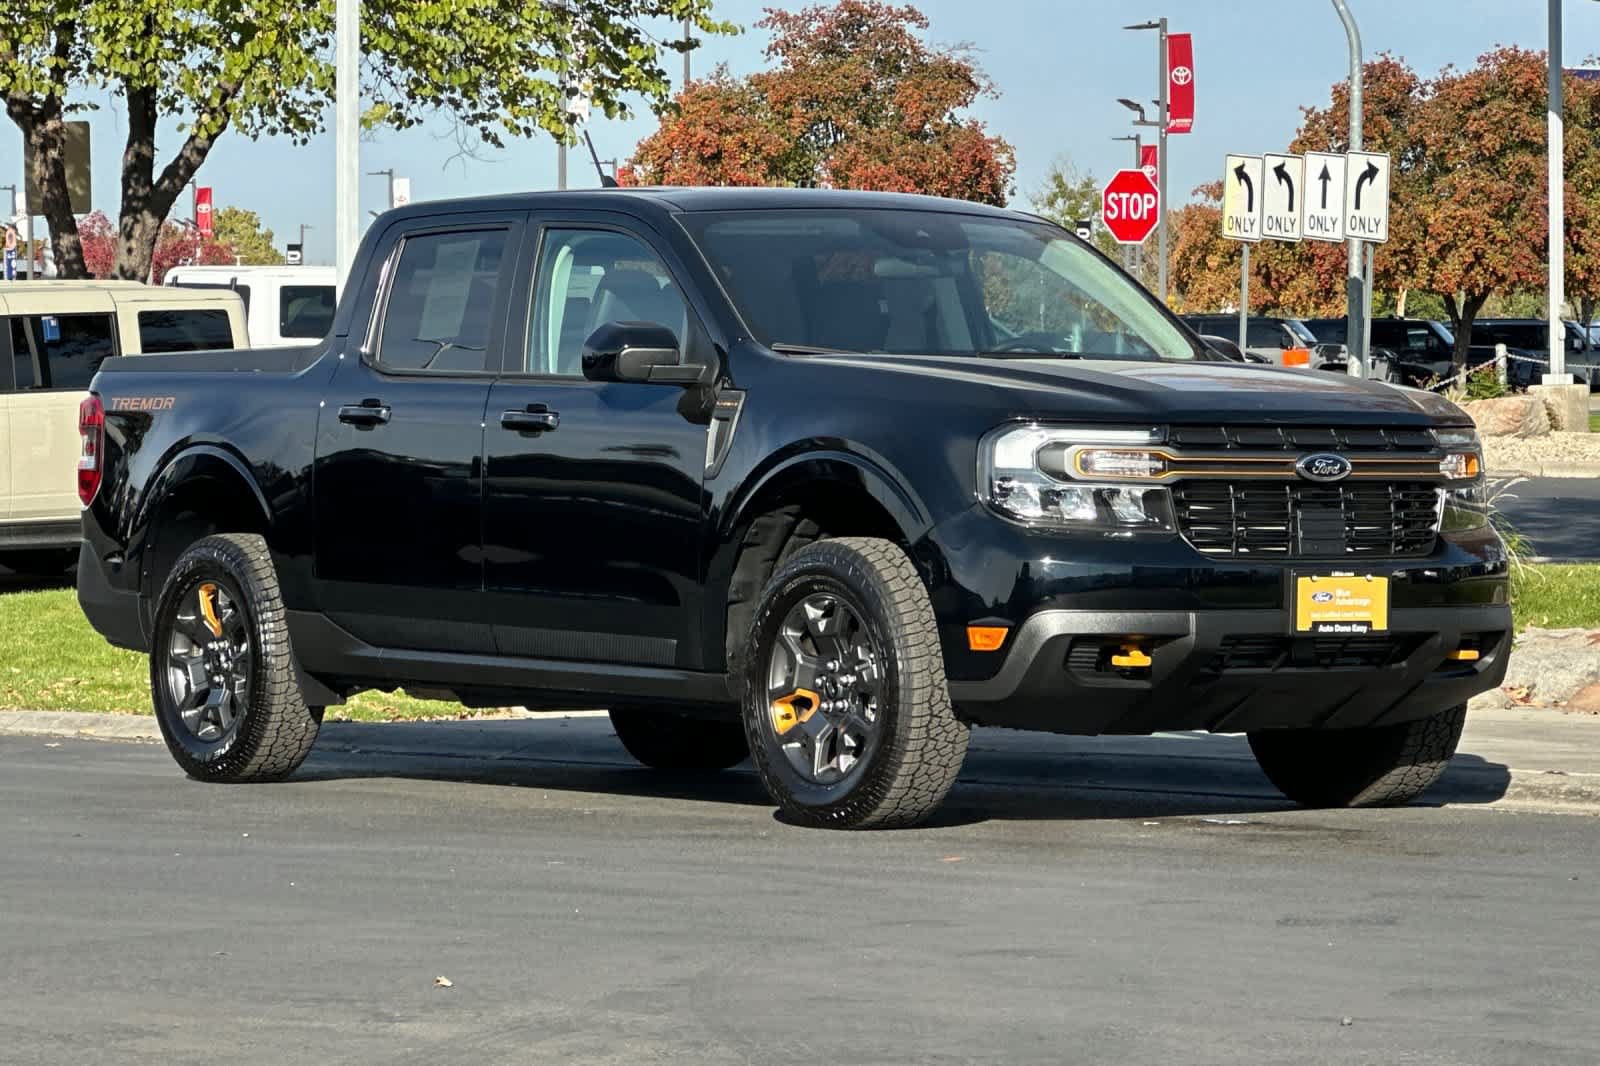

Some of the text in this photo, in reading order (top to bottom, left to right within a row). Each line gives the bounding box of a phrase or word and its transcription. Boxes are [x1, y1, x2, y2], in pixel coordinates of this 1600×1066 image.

[1106, 192, 1156, 220] STOP
[1227, 215, 1256, 233] ONLY
[1266, 215, 1297, 233] ONLY
[1308, 214, 1338, 233] ONLY
[1350, 215, 1381, 234] ONLY
[111, 396, 176, 410] TREMOR
[1312, 459, 1340, 474] Ford
